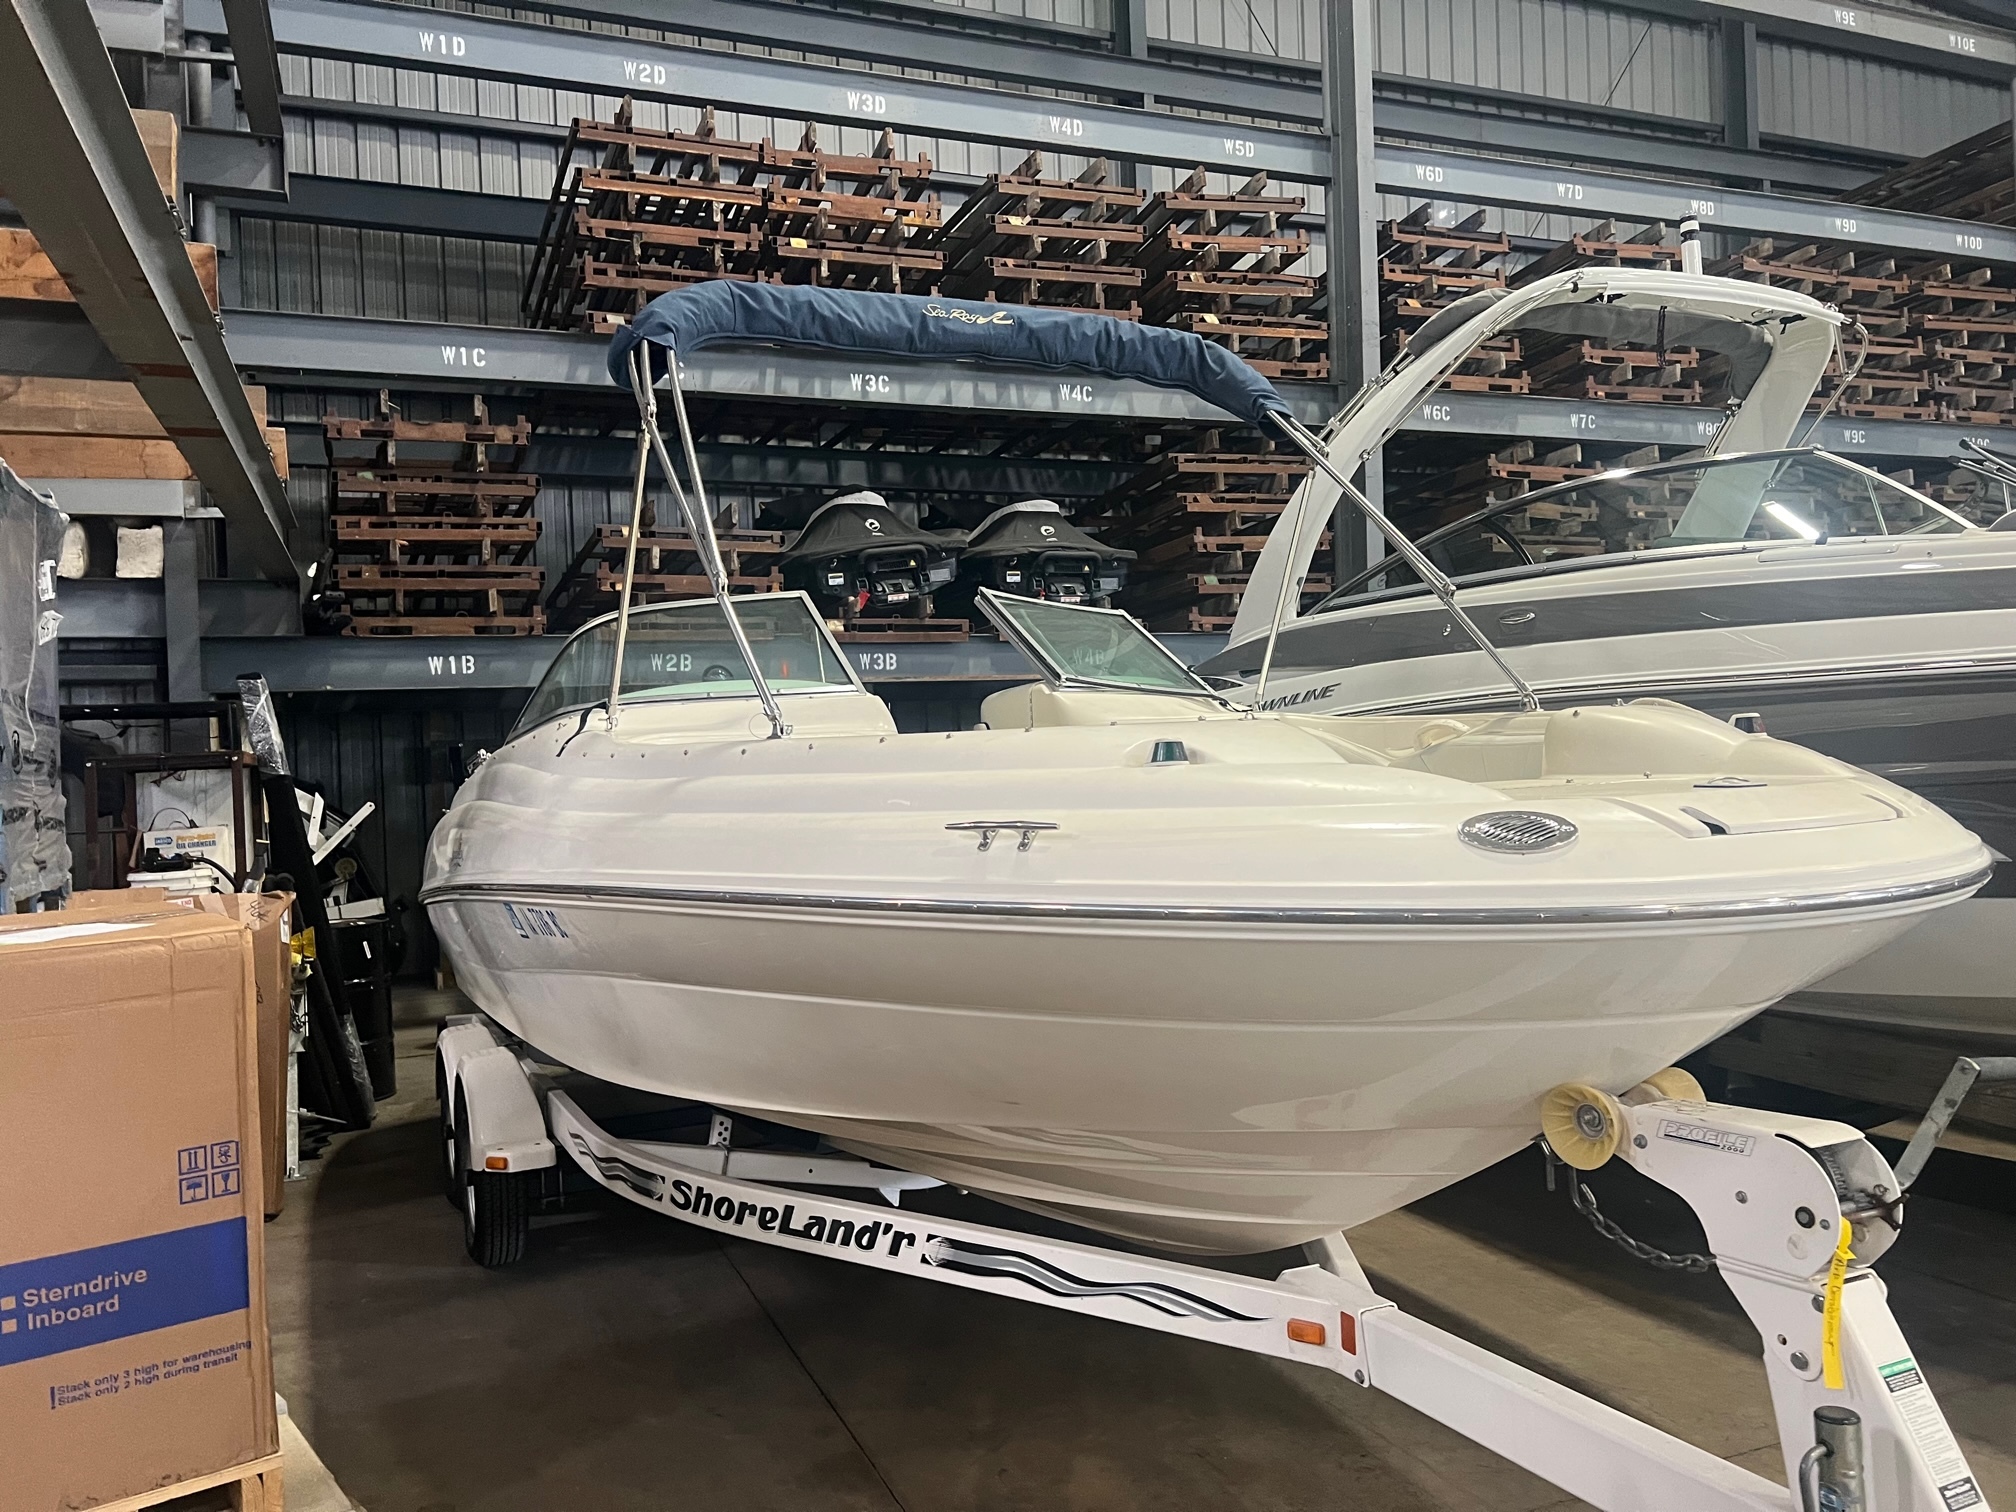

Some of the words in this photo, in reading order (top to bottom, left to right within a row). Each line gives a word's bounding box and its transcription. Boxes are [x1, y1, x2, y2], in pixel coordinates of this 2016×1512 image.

[1834, 9, 1856, 26] W9E
[418, 31, 466, 57] W1D
[1948, 34, 1976, 53] W10E
[623, 60, 666, 85] W2D
[847, 91, 886, 114] W3D
[1049, 115, 1083, 137] W4D
[1223, 138, 1255, 158] W5D
[1415, 164, 1443, 183] W6D
[1556, 182, 1583, 200] W7D
[1690, 199, 1715, 216] W8D
[1834, 218, 1857, 233] W9D
[1955, 234, 1982, 250] W10D
[922, 304, 949, 318] Sea
[949, 308, 981, 325] Ray
[441, 345, 486, 367] W1C
[850, 373, 890, 393] W3C
[1059, 383, 1093, 403] W4C
[1422, 404, 1451, 422] W6C
[1570, 413, 1596, 429] W7C
[1843, 429, 1866, 444] W9C
[428, 655, 476, 676] W1B
[650, 653, 692, 673] W2B
[859, 653, 898, 671] W3B
[1261, 682, 1341, 711] WNLINE
[1665, 1121, 1749, 1149] PROFILE
[1720, 1144, 1744, 1153] 2000
[669, 1179, 917, 1258] ShoreLand'r
[23, 1269, 148, 1307] Sterndrive
[27, 1294, 120, 1331] Inboard
[57, 1379, 91, 1396] Stack
[94, 1373, 119, 1387] only
[123, 1369, 130, 1379] 3
[134, 1363, 159, 1378] high
[162, 1357, 179, 1369] for
[182, 1340, 252, 1364] warehousing
[57, 1389, 92, 1407] Stack
[95, 1383, 120, 1398] only
[124, 1380, 131, 1389] 2
[134, 1373, 160, 1387] high
[163, 1363, 200, 1379] during
[203, 1352, 239, 1369] transit
